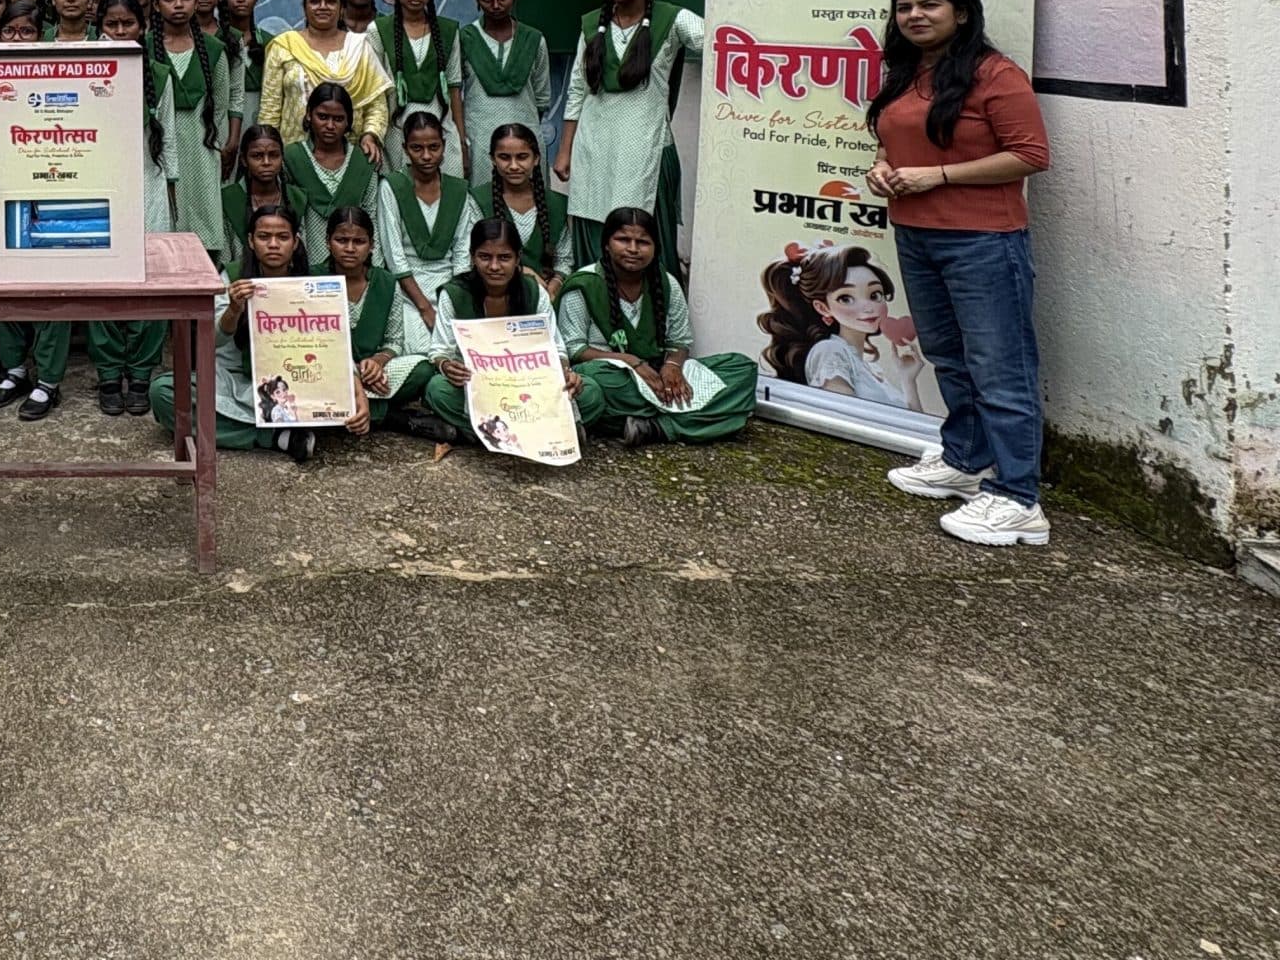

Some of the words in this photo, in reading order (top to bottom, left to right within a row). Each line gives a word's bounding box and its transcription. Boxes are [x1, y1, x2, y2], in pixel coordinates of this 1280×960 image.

[811, 9, 844, 23] प्रस्तुत
[846, 7, 876, 21] करते
[58, 62, 83, 76] PAD
[85, 62, 111, 76] BOX
[715, 102, 765, 122] Drive
[769, 110, 795, 128] for
[10, 124, 98, 145] किरणोत्सव
[743, 128, 766, 141] Pad
[770, 130, 789, 143] For
[794, 133, 831, 149] Pride,
[835, 137, 880, 153] Protec
[839, 162, 869, 177] पार्टन
[753, 189, 843, 224] प्रभात
[256, 308, 342, 335] किरणोत्सव
[467, 347, 552, 374] किरणोत्सव
